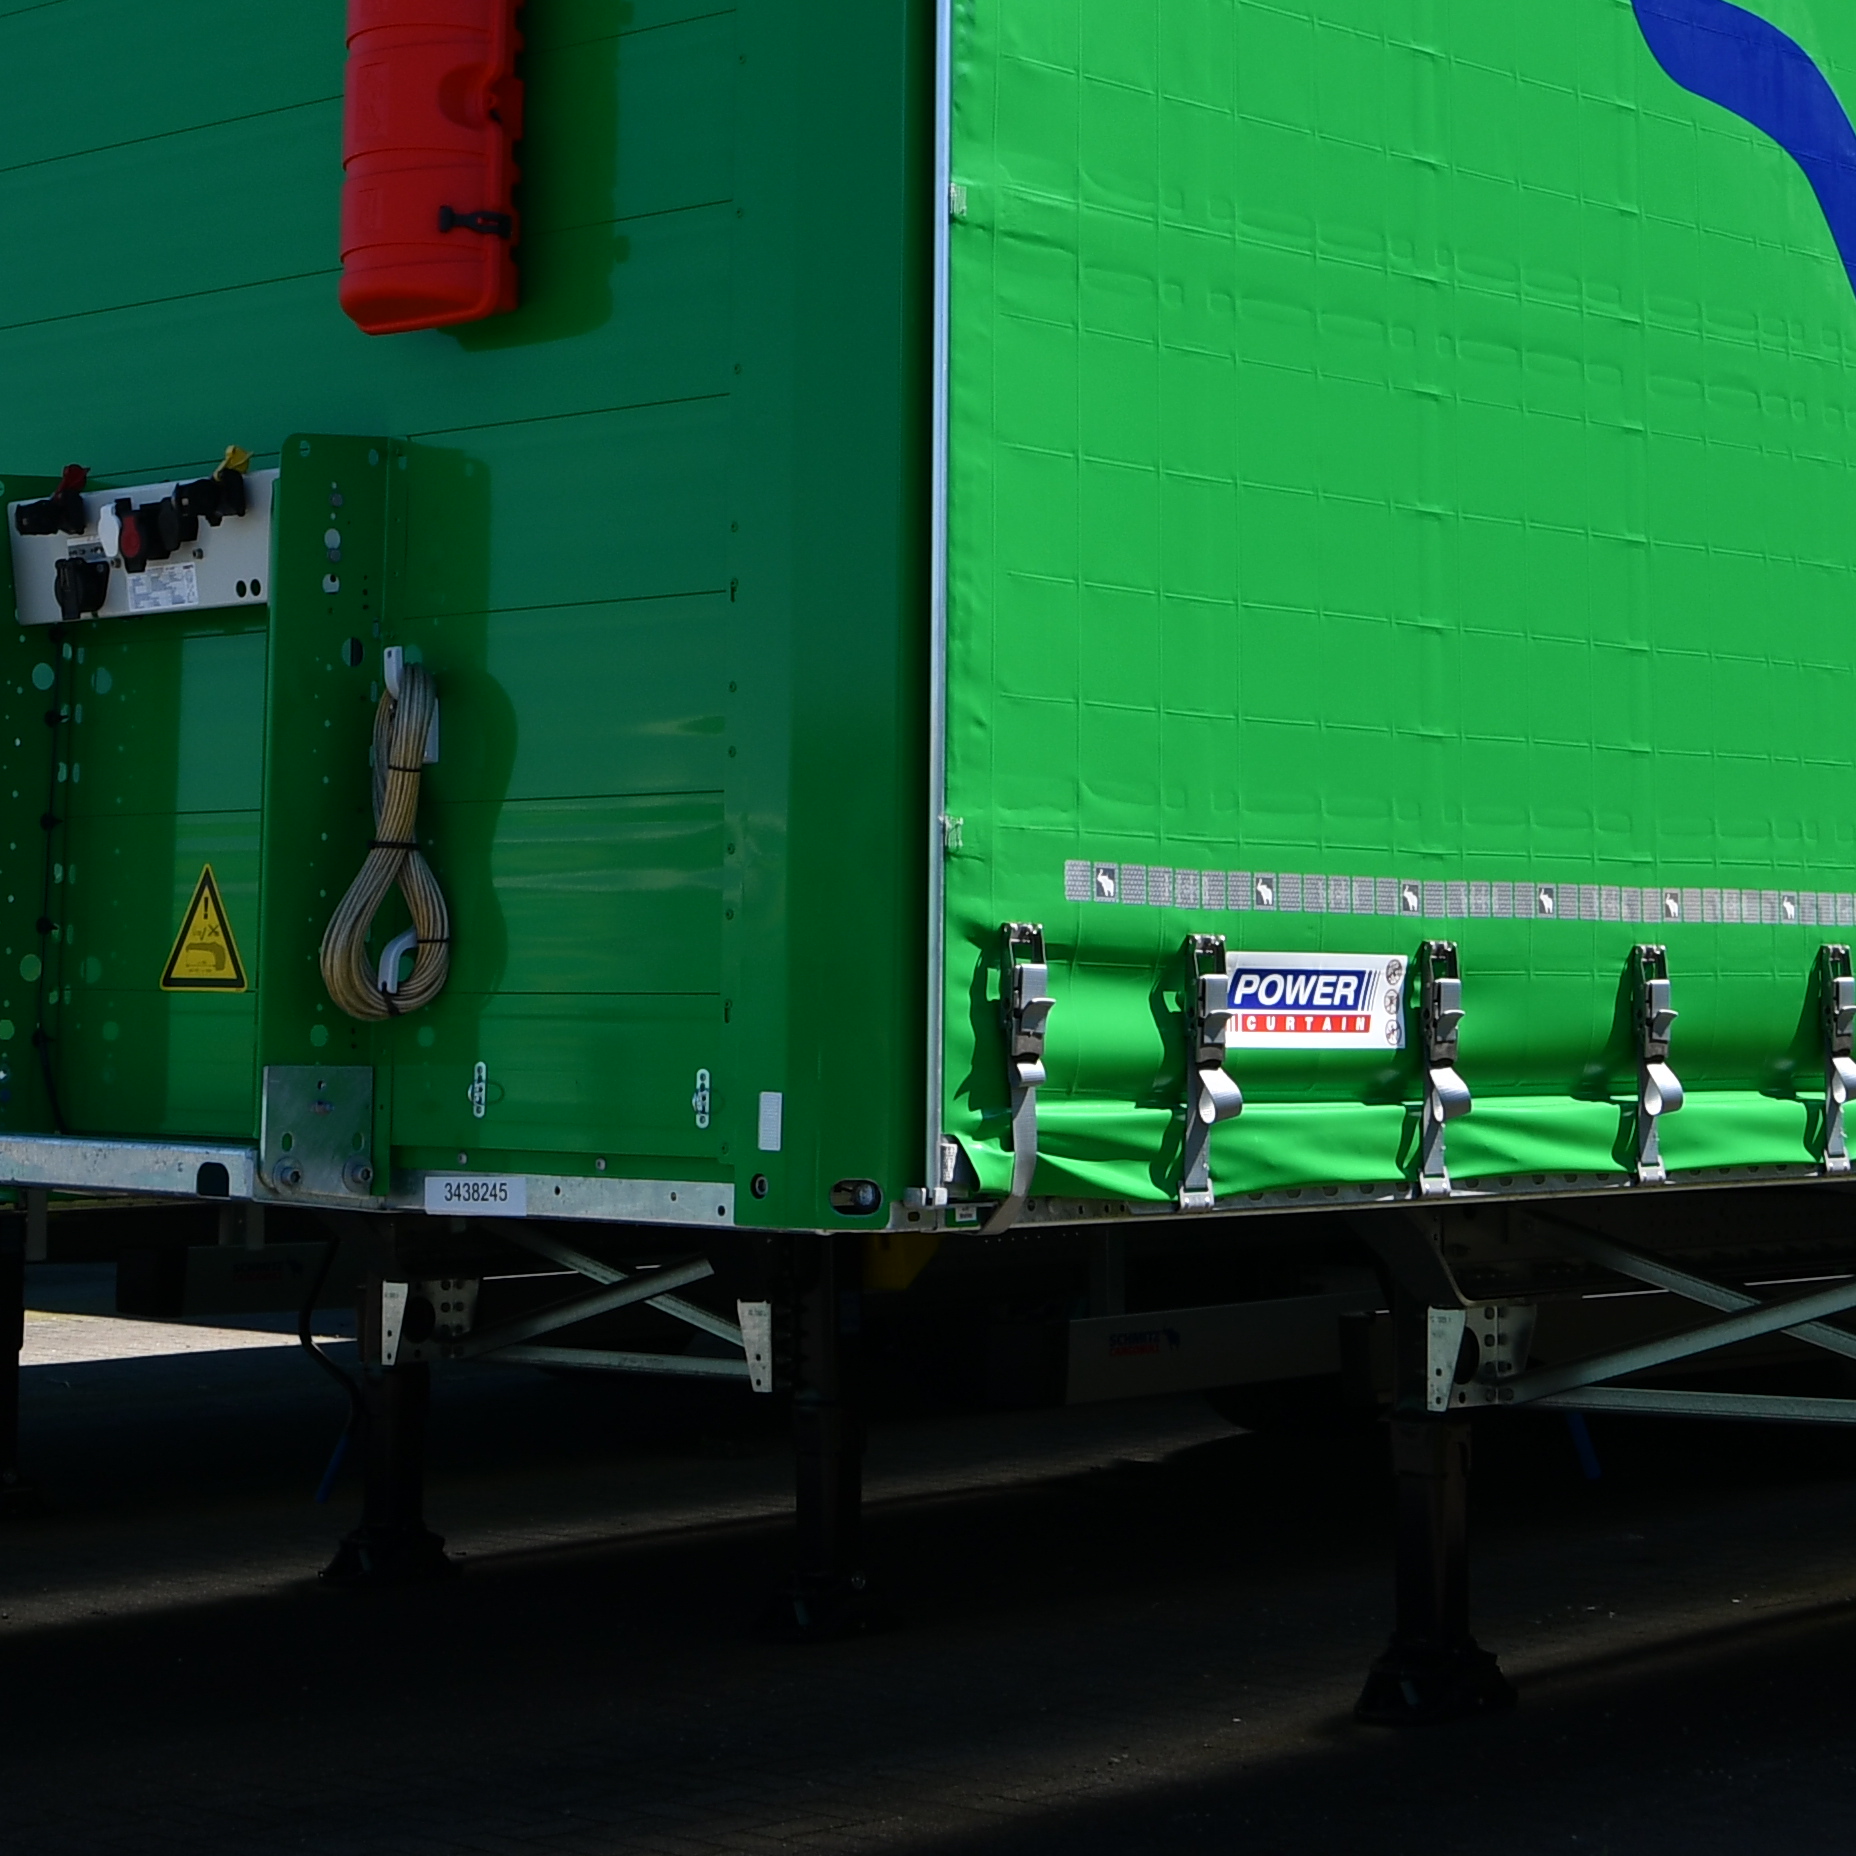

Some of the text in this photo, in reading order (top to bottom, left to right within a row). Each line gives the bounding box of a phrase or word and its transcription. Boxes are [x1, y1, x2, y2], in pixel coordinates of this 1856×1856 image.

[1233, 973, 1359, 1006] POWER
[1246, 1015, 1366, 1032] CURTAIN
[444, 1182, 508, 1202] 3438245
